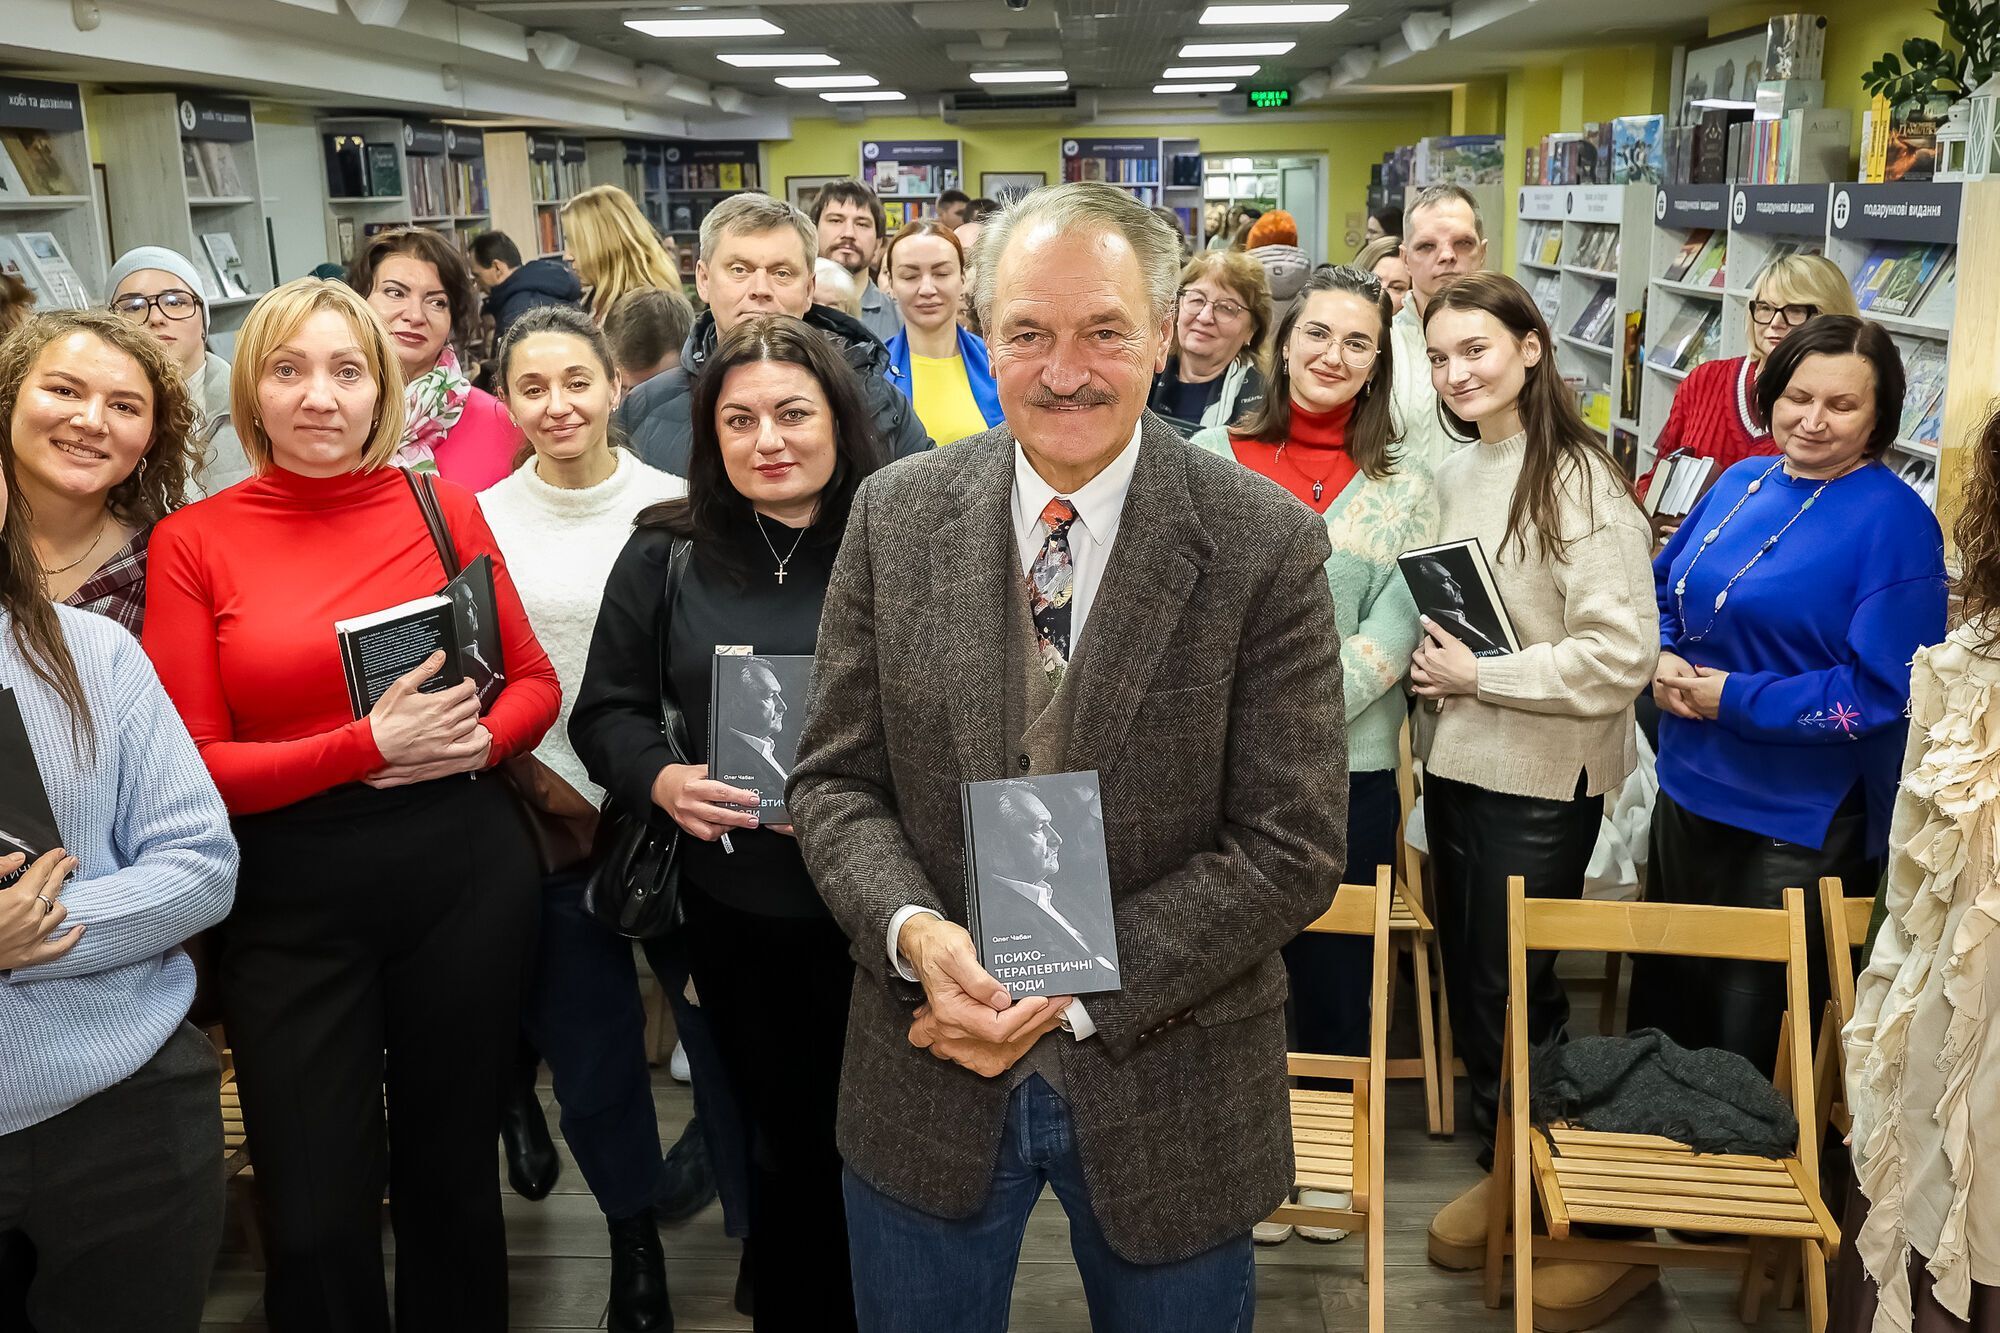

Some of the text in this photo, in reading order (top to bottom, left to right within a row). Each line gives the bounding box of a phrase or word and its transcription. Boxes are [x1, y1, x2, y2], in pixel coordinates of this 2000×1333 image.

[29, 96, 38, 108] та
[1864, 200, 1941, 218] подарункові видання
[992, 932, 1032, 944] Олег Чабан
[994, 950, 1046, 965] ПСИХО-
[995, 958, 1093, 979] ТЕРАПЕВТИЧНІ
[1000, 978, 1045, 993] ТЮДИ
